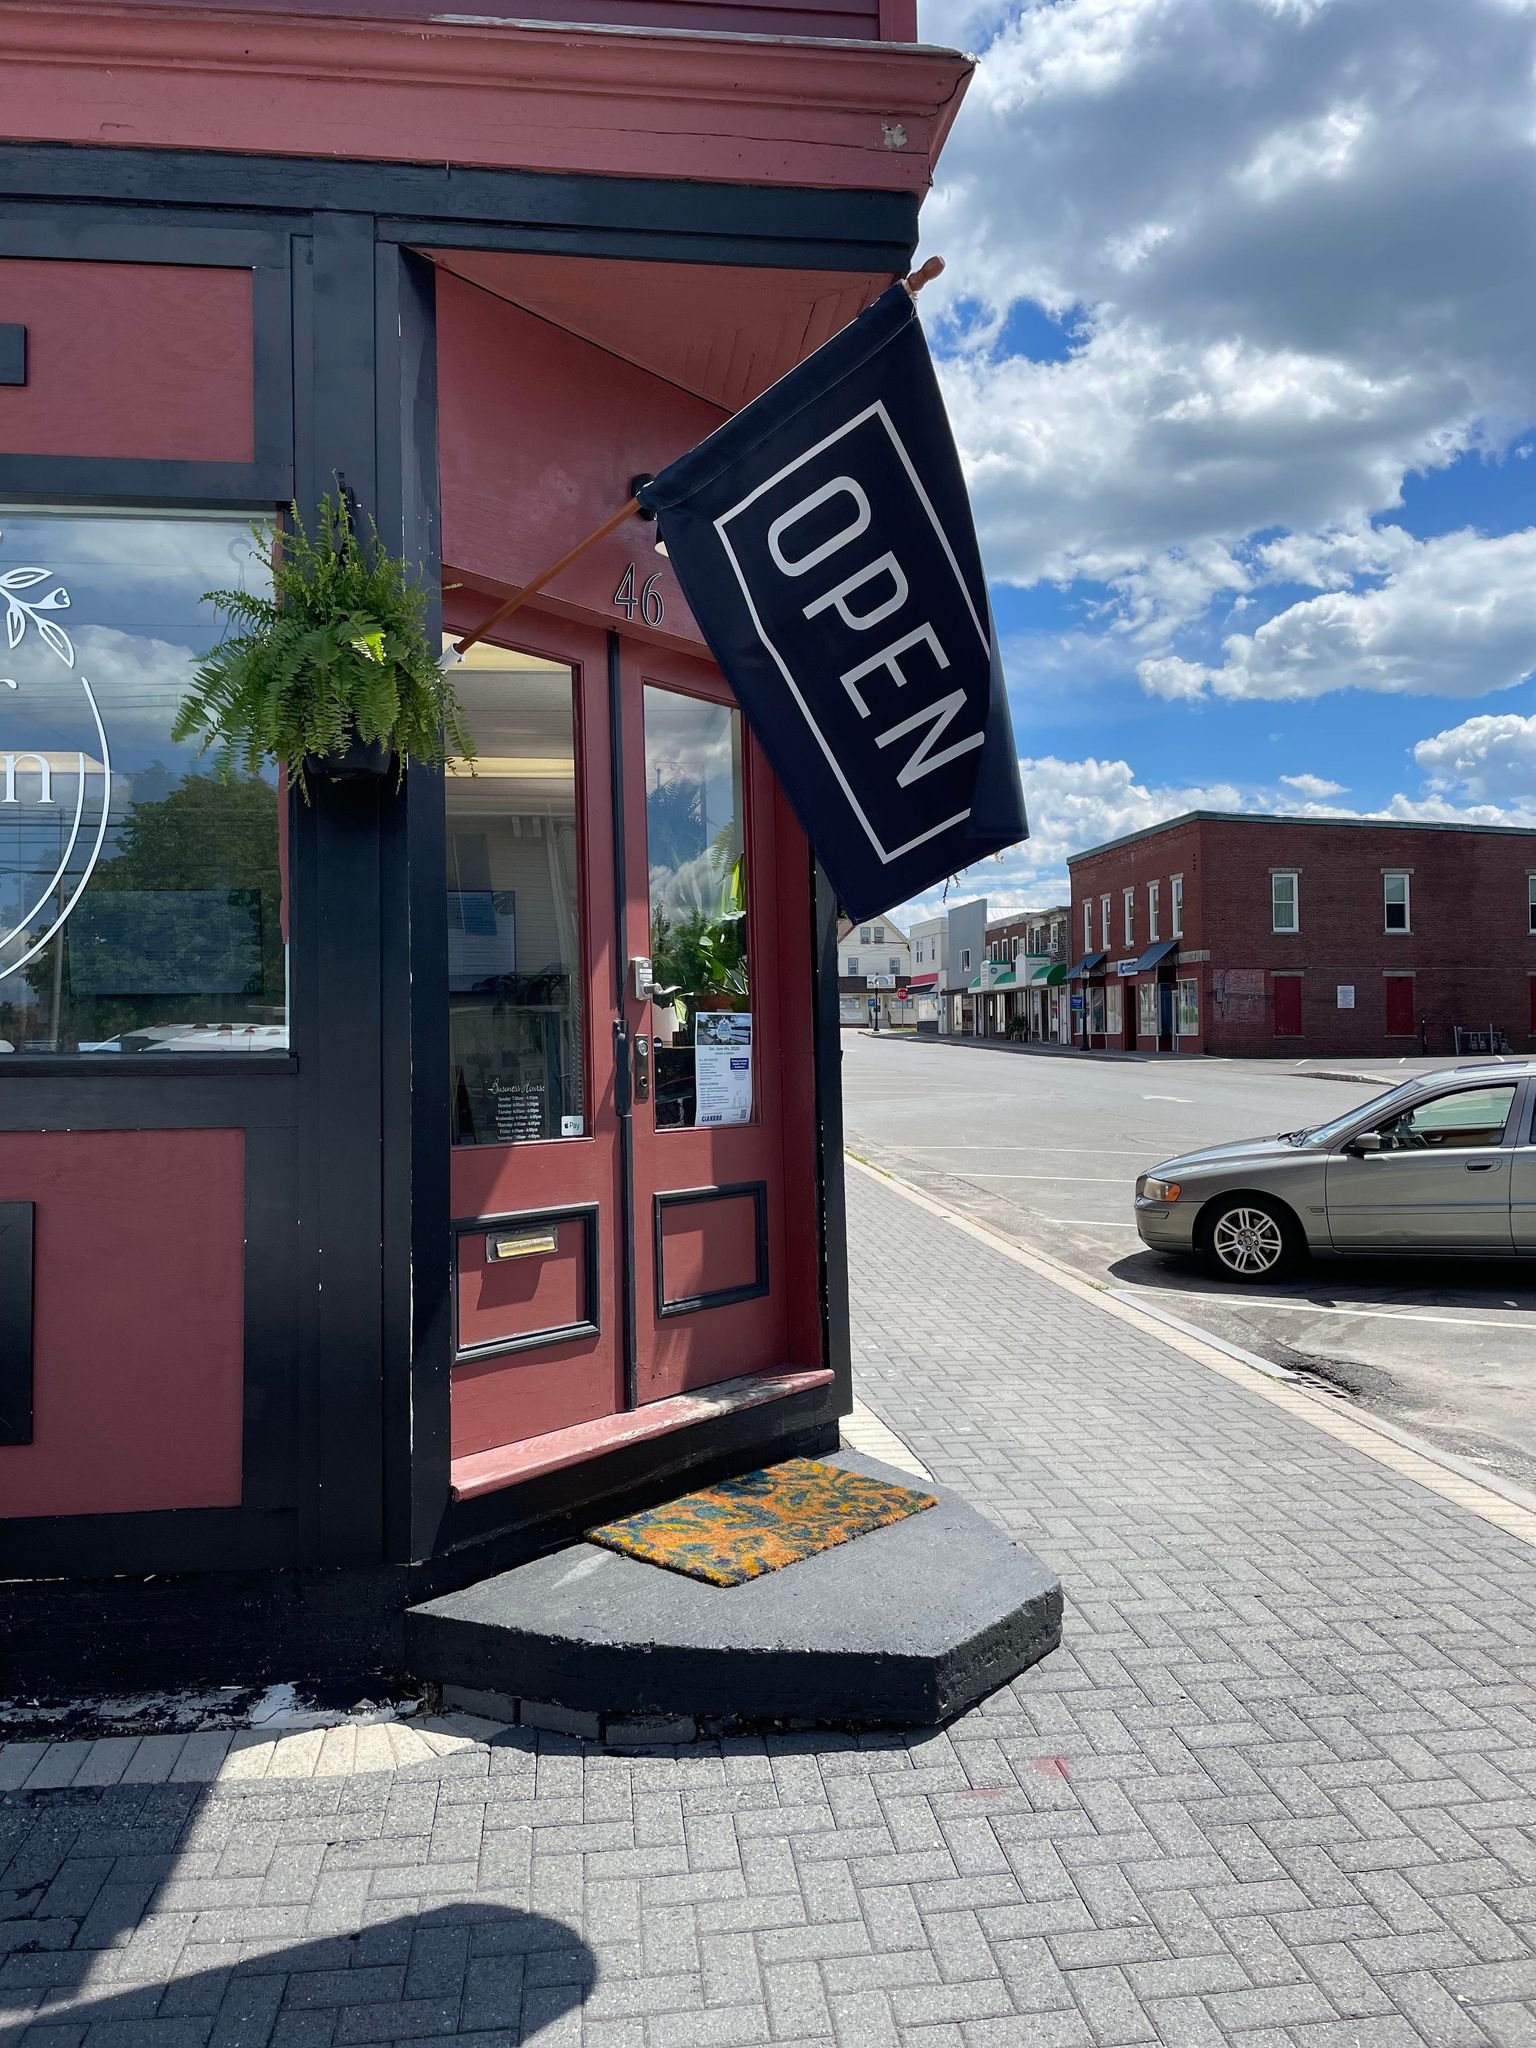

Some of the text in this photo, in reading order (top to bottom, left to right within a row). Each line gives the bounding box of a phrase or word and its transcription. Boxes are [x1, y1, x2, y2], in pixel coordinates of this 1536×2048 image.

[614, 562, 665, 627] 46
[766, 474, 986, 789] OPEN
[488, 1077, 520, 1094] Business
[569, 1121, 580, 1131] Pay
